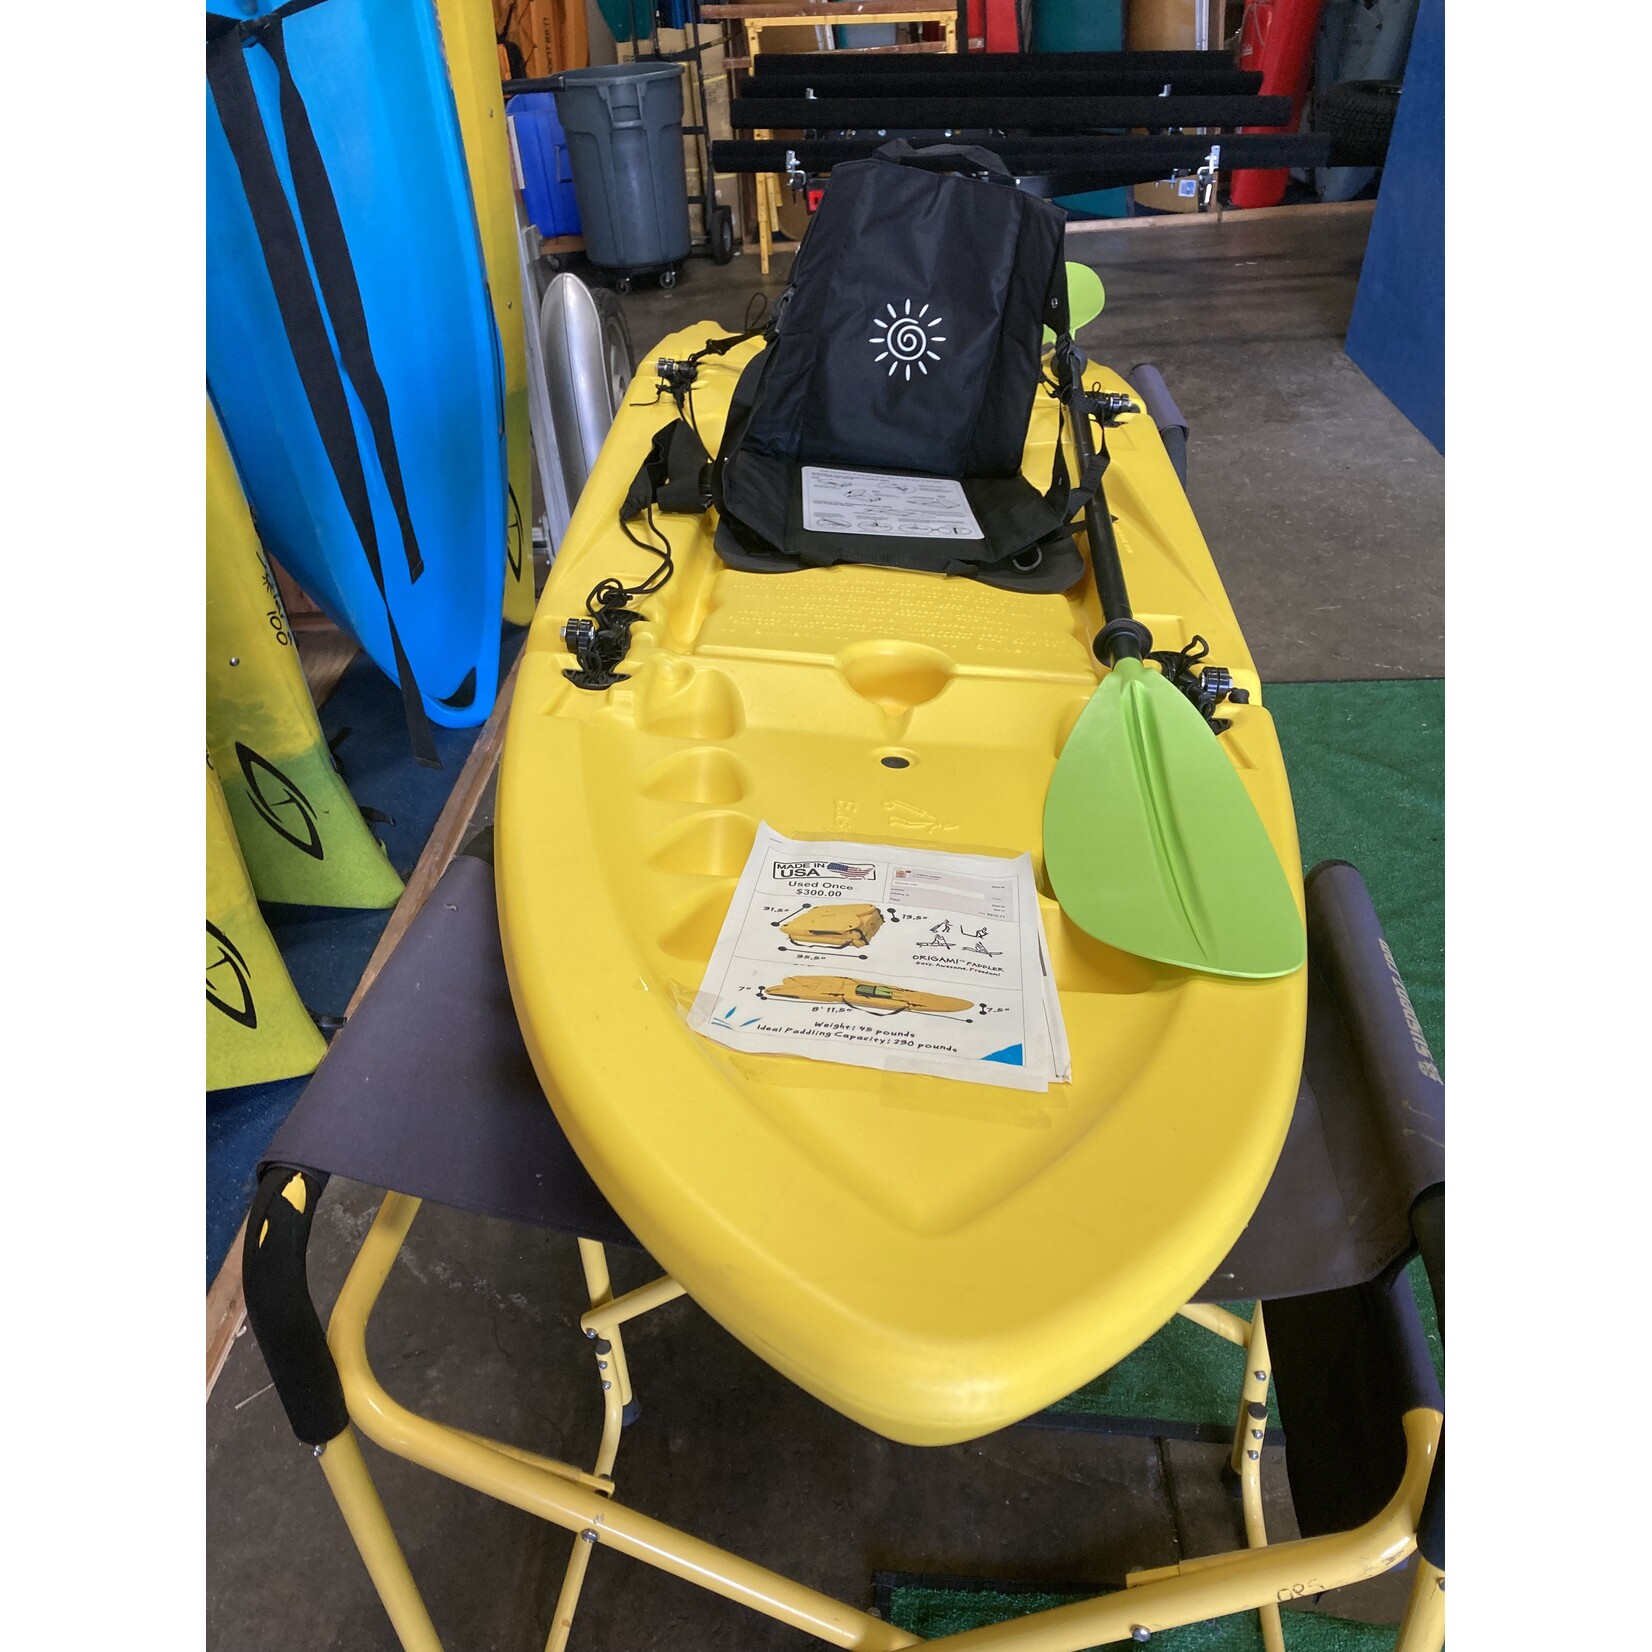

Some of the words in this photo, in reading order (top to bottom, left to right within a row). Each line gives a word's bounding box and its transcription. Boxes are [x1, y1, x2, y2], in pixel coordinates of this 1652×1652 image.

[267, 611, 289, 645] 100
[781, 868, 820, 877] USA
[822, 882, 853, 890] Once
[796, 888, 842, 897] $300.00
[966, 961, 1004, 972] PADDLER
[814, 1021, 856, 1031] Weight:
[875, 1028, 916, 1038] pounds
[756, 1024, 783, 1033] Ideal
[785, 1027, 832, 1038] Paddling
[834, 1031, 891, 1045] Capacity:
[917, 1042, 958, 1053] pounds
